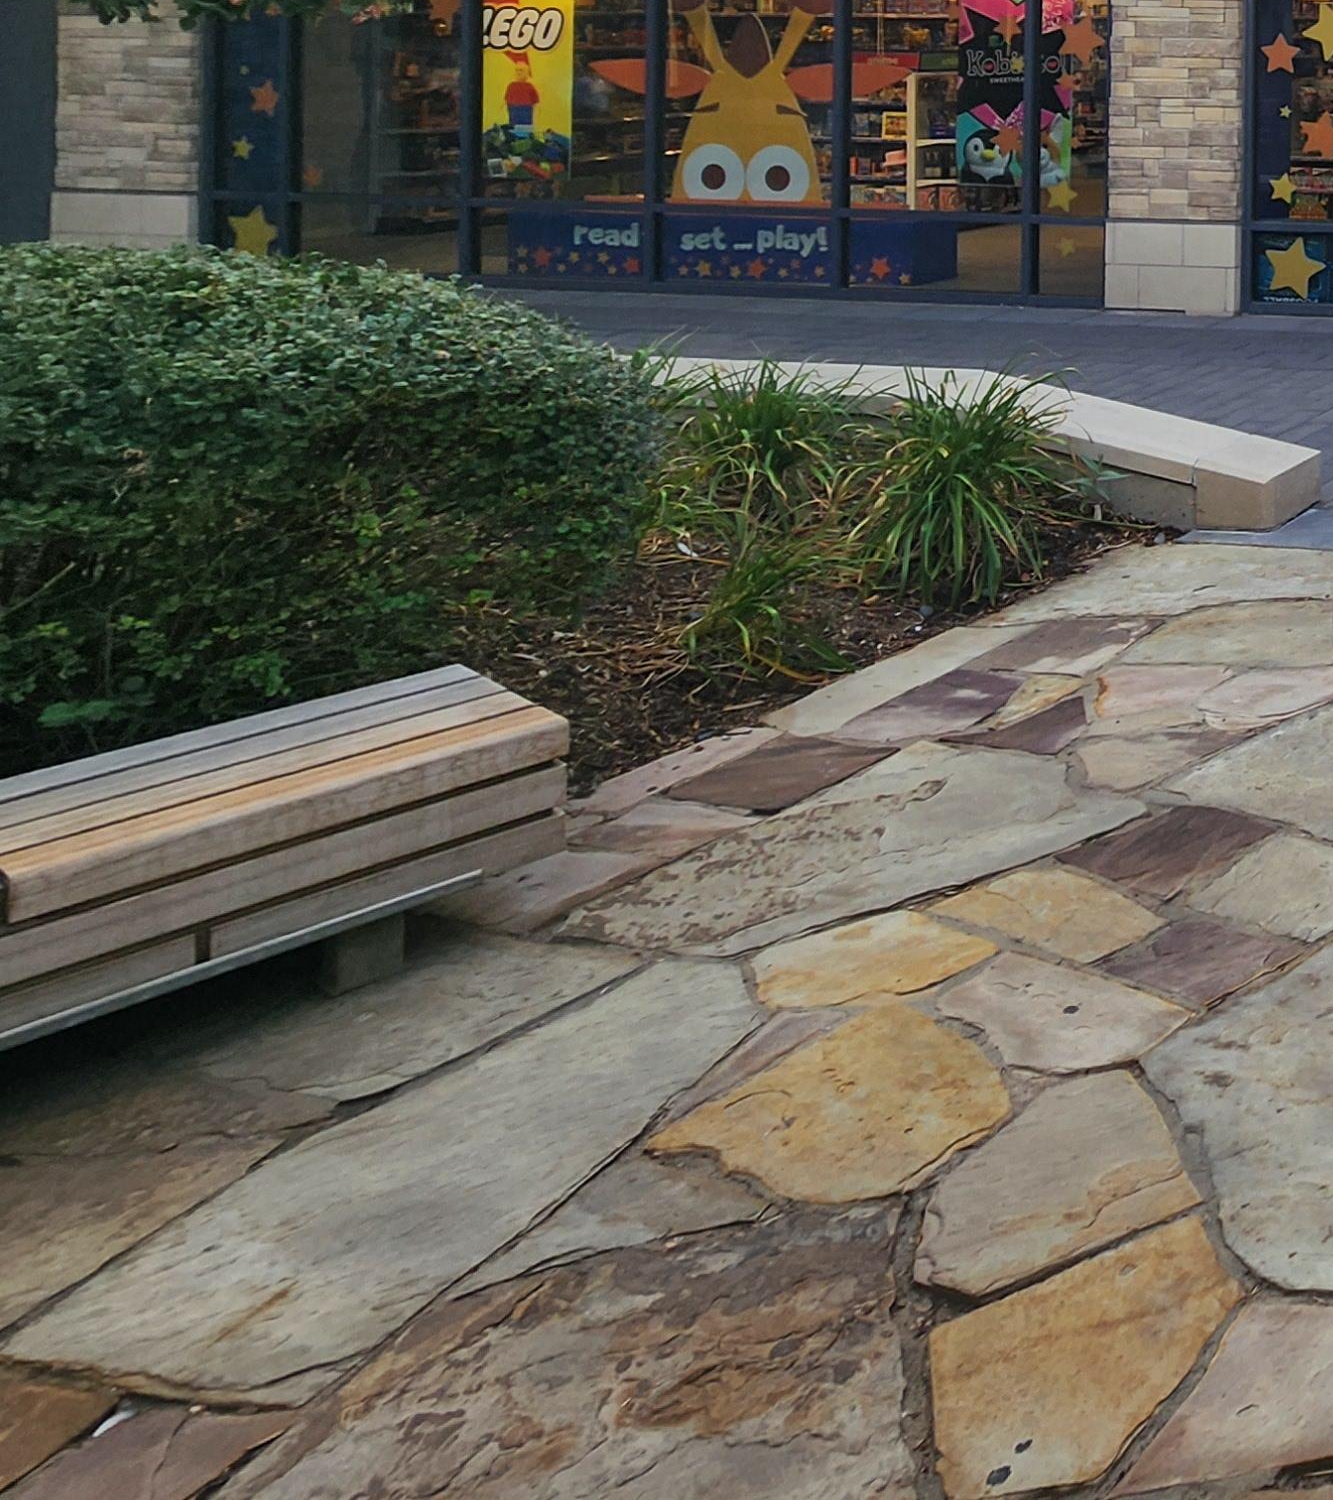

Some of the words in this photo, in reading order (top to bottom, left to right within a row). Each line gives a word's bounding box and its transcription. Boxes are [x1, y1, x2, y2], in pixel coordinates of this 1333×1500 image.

[573, 222, 640, 247] read
[680, 226, 728, 251] set
[756, 224, 829, 258] play!
